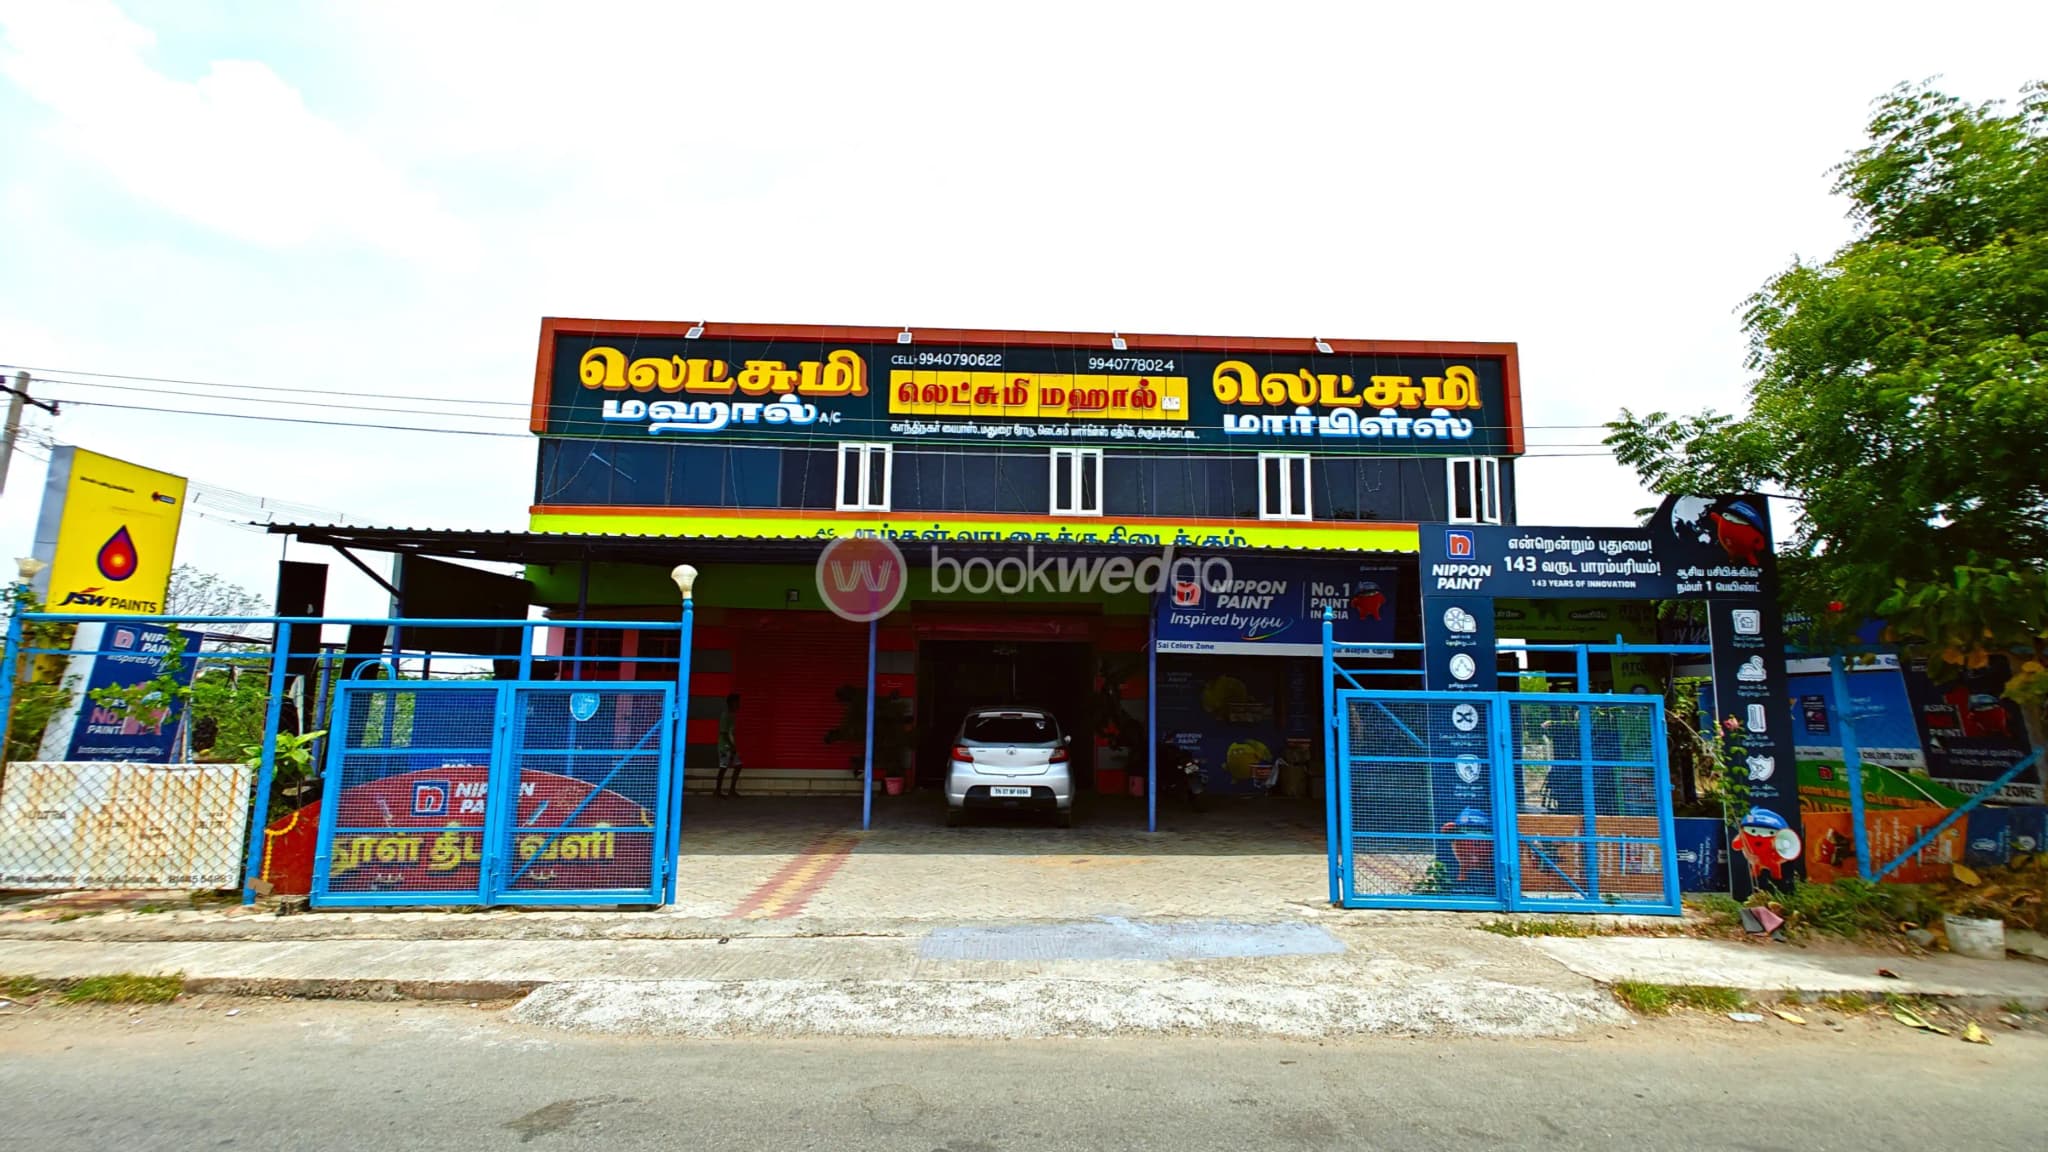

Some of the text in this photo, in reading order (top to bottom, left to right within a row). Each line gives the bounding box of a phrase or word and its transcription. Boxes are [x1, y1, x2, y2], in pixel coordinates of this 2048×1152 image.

[919, 352, 1002, 367] 9940790622
[1089, 357, 1174, 371] 9940778024
[580, 347, 868, 395] லெட்சுமி
[1213, 361, 1481, 409] லெட்சுமி
[899, 378, 1030, 407] லெட்சுமி
[1040, 378, 1157, 412] மஹால்
[602, 394, 841, 434] மஹால் A/C
[1223, 406, 1473, 439] மார்பிள்ஸ்
[1508, 535, 1653, 556] என்றென்றும் புதுமை!
[1432, 564, 1492, 577] NIPPON
[1504, 556, 1537, 572] 143
[1542, 561, 1577, 576] வருட
[1212, 580, 1287, 595] NIPPON
[1437, 577, 1483, 590] PAINT
[1531, 579, 1636, 588] 143 YEARS OF INNOVATION
[57, 592, 158, 613] JSW PAINTS
[1216, 596, 1275, 610] PAINT
[1311, 598, 1350, 609] PAINT
[1310, 610, 1349, 620] IN SIA
[1170, 612, 1285, 637] Inspired by you
